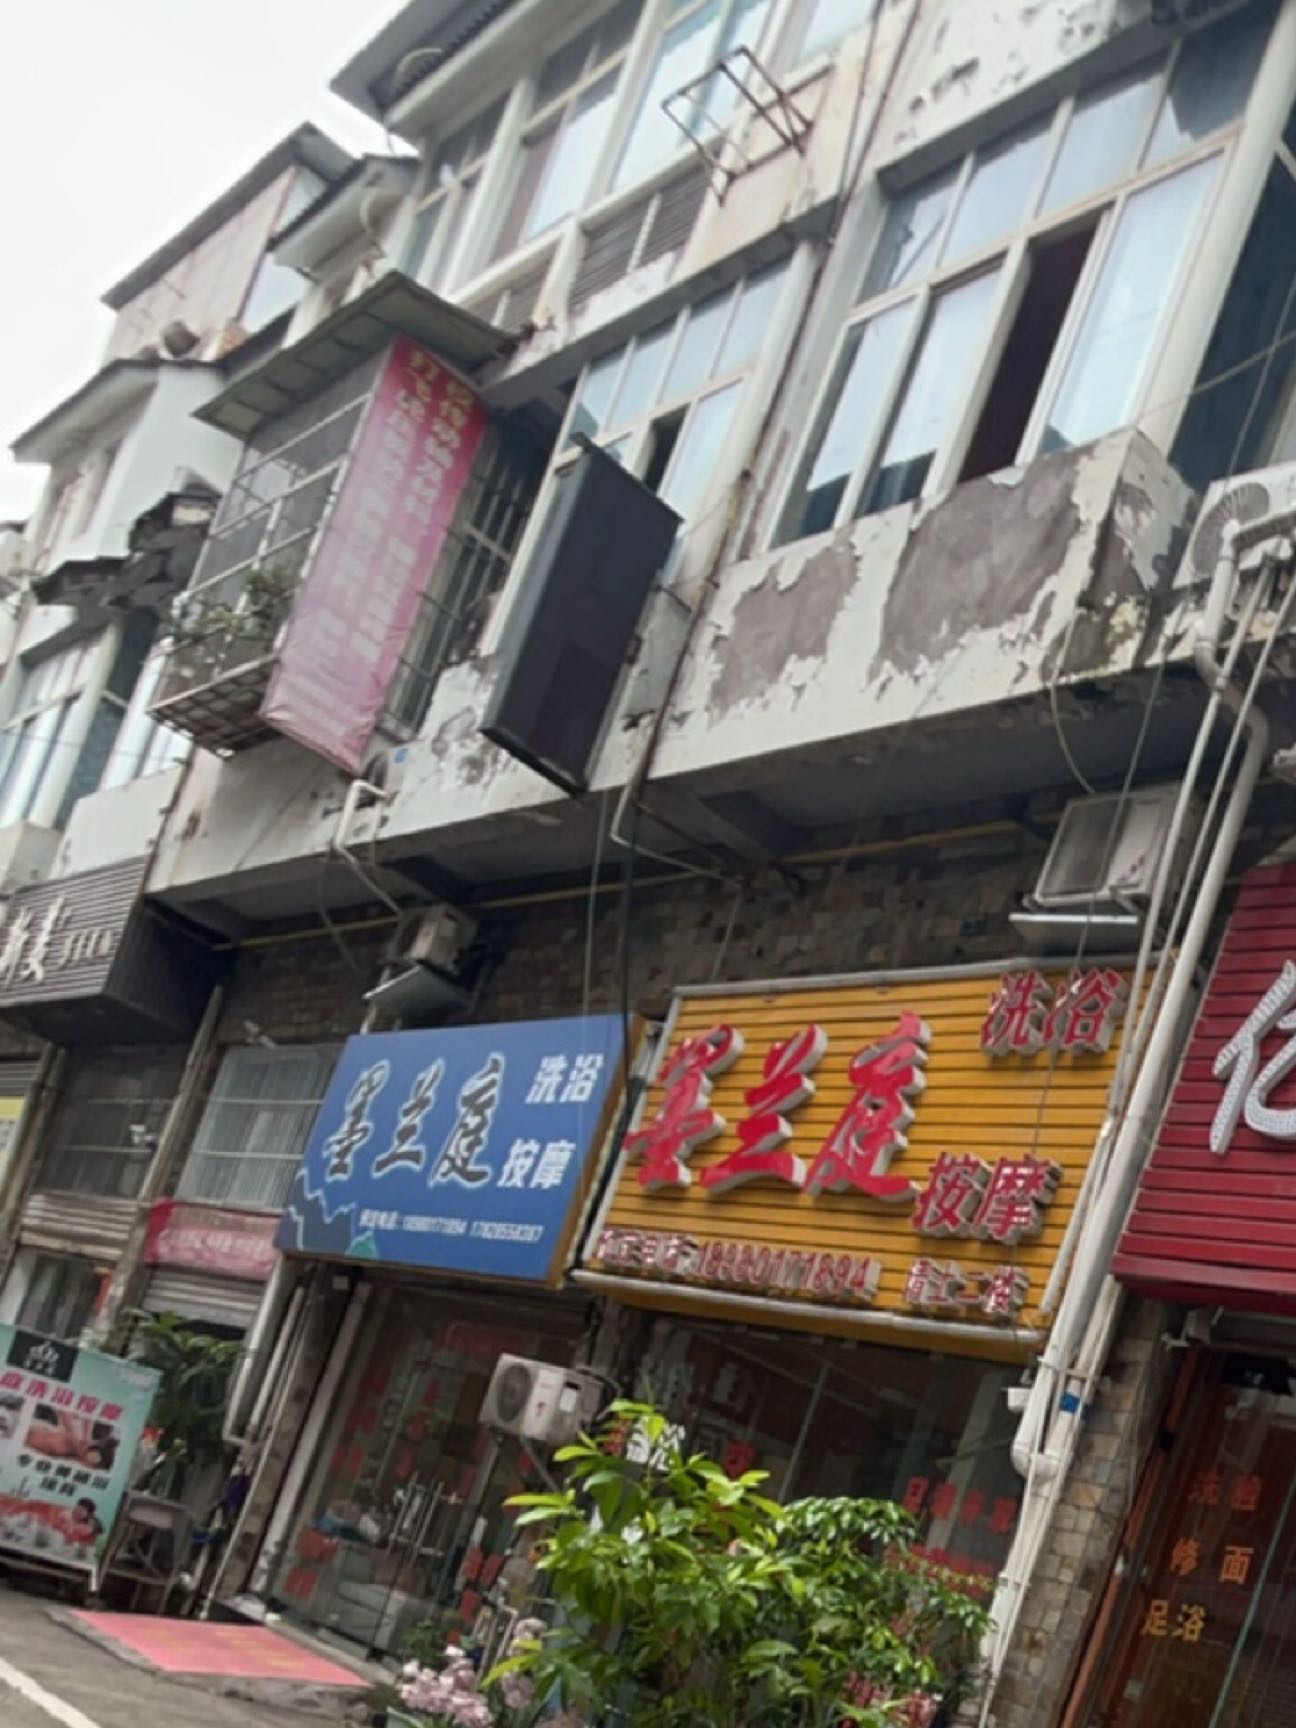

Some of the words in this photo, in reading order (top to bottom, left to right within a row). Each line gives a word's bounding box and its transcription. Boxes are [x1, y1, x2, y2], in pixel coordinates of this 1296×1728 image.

[981, 967, 1128, 1058] 洗浴
[524, 1053, 604, 1105] 洗浴
[496, 1137, 577, 1190] 按摩
[911, 1150, 1062, 1246] 按摩
[1141, 1599, 1207, 1643] 足浴
